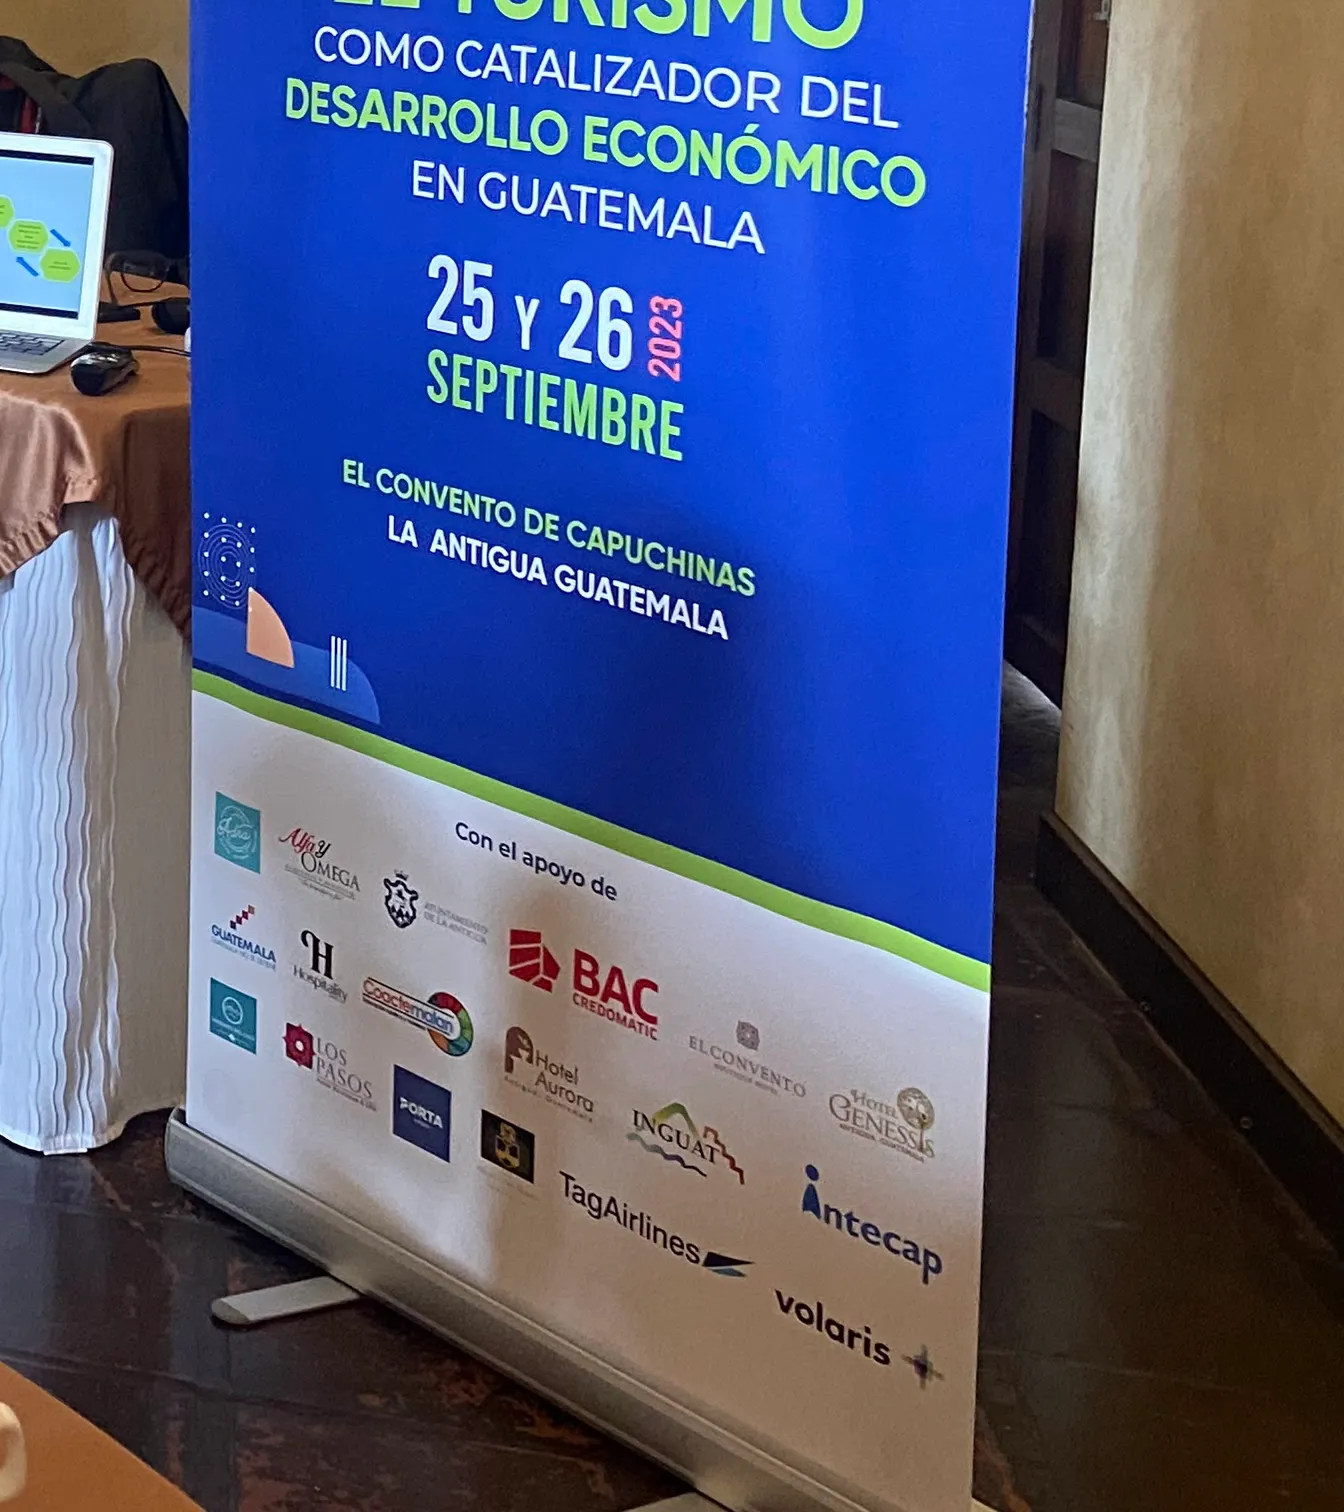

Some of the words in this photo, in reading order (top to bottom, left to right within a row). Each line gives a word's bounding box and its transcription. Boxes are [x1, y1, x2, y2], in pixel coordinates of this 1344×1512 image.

[313, 25, 444, 74] COMO
[455, 39, 781, 115] CATALIZADOR
[801, 76, 900, 129] DEL
[286, 78, 569, 156] DESARROLLO
[584, 118, 926, 207] ECONÓMICO
[412, 160, 465, 204] EN
[478, 171, 766, 255] GUATEMALA
[426, 254, 494, 343] 25
[514, 294, 540, 351] Y
[558, 279, 633, 372] 26
[648, 296, 683, 382] 2023
[426, 348, 684, 462] SEPTIEMBRE
[343, 458, 370, 490] EL
[376, 468, 516, 528] CONVENTO
[524, 507, 560, 543] DE
[566, 520, 756, 597] CAPUCHINAS
[388, 515, 418, 548] LA
[430, 532, 548, 586] ANTIGUA
[554, 564, 728, 640] GUATEMALA
[301, 851, 360, 892] OMEGA
[455, 822, 493, 851] Con
[499, 841, 516, 861] el
[523, 851, 585, 885] apoyo
[591, 877, 618, 901] de
[211, 924, 276, 962] GUATEMALA
[573, 992, 658, 1041] CREDOMATIC
[574, 948, 659, 1025] BAC
[317, 1037, 346, 1067] LOS
[317, 1057, 373, 1100] PASOS
[535, 1049, 578, 1086] Hotel
[709, 1045, 806, 1098] CONVENTO
[399, 1097, 444, 1130] PORTA
[534, 1071, 594, 1113] Aurora
[632, 1108, 720, 1165] INGUAT
[559, 1171, 701, 1266] TagAirlines
[774, 1289, 891, 1367] volaris
